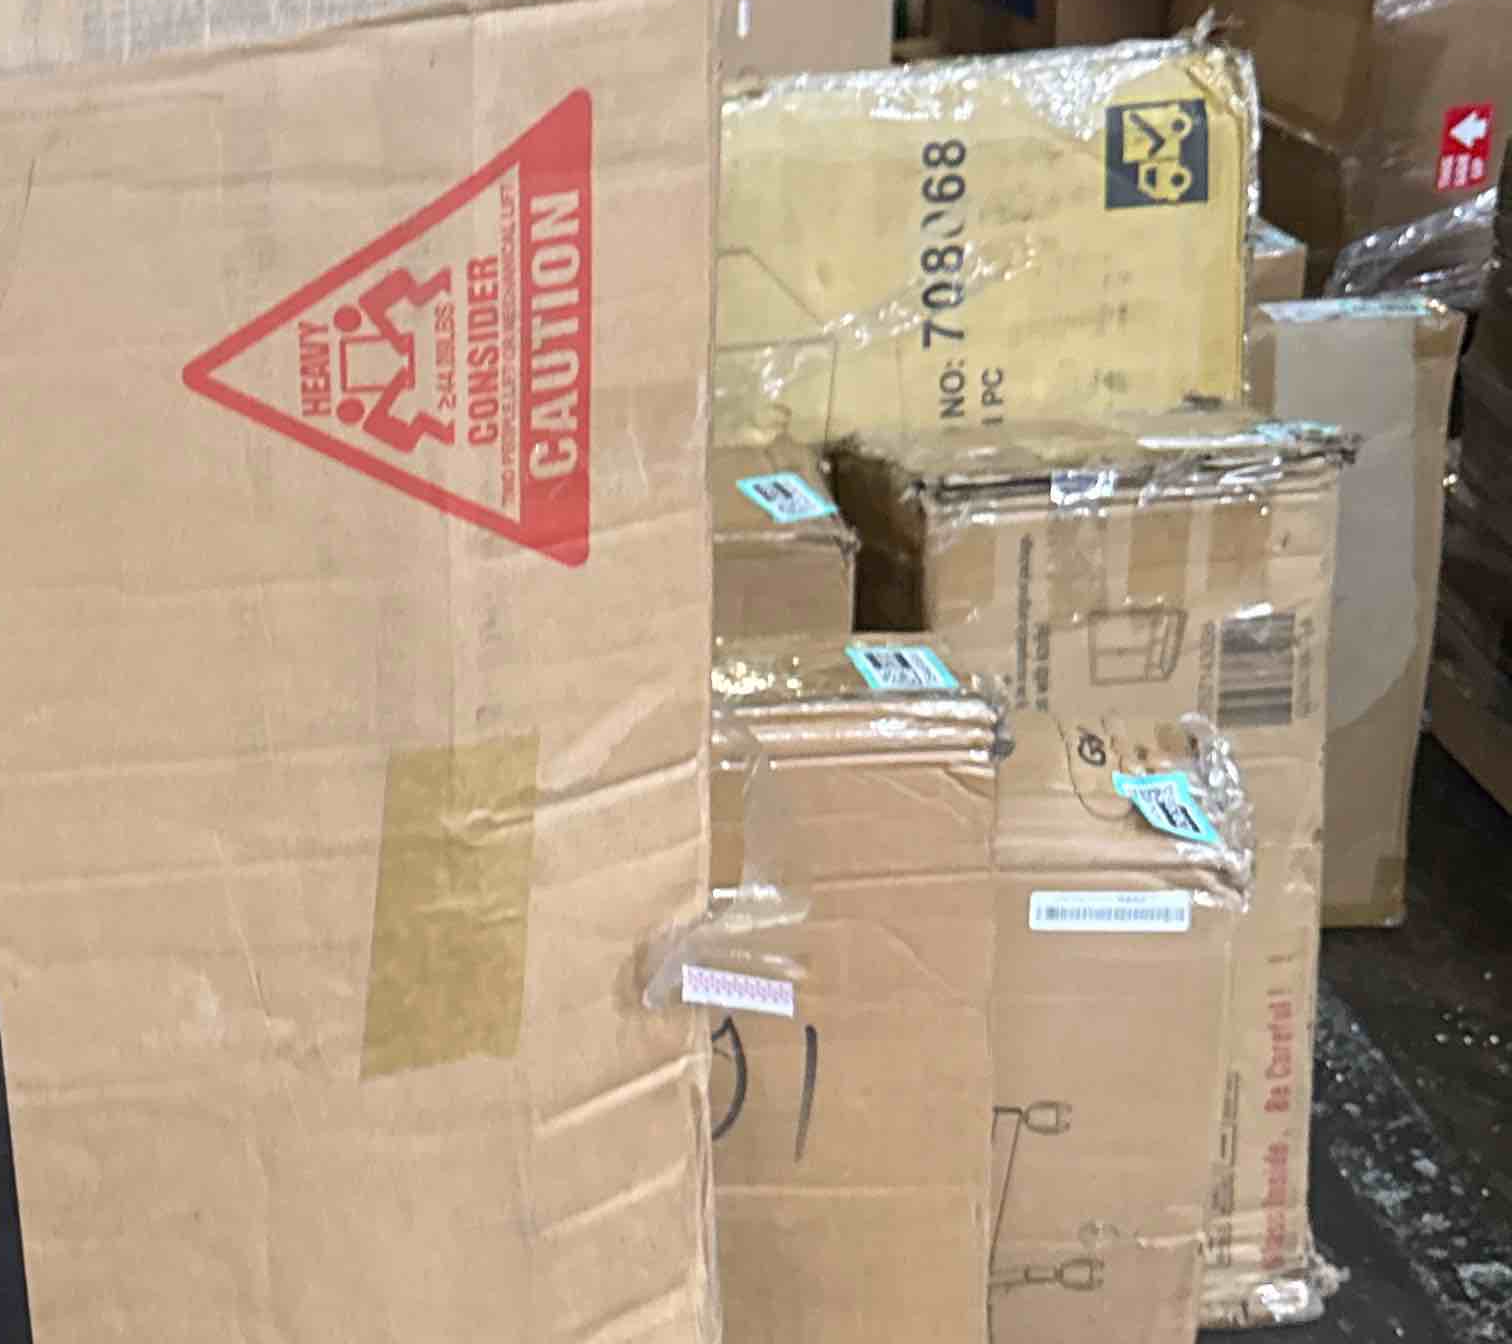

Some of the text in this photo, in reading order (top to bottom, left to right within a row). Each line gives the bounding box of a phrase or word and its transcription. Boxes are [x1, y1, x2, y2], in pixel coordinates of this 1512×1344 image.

[298, 320, 332, 418] HEAVY
[467, 256, 499, 446] CONSIDER
[529, 187, 582, 480] CAUTION
[939, 358, 966, 420] NO:
[981, 366, 1004, 408] PC
